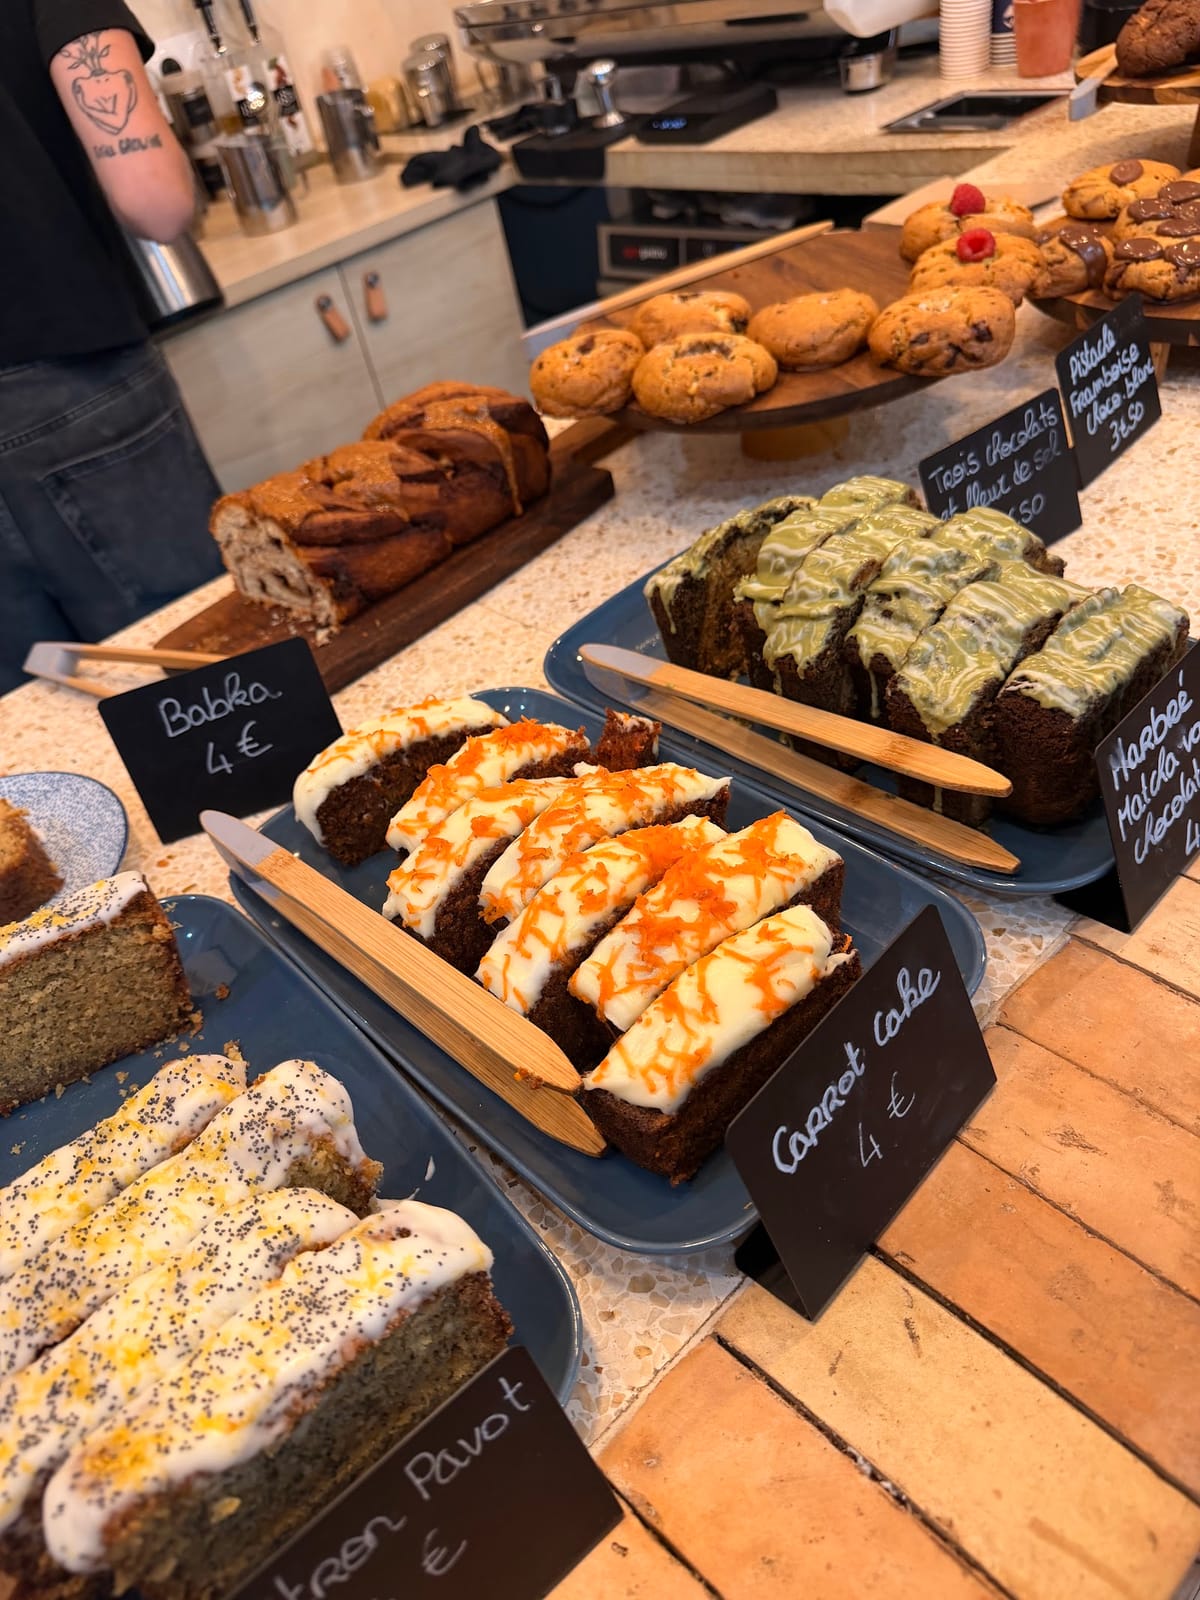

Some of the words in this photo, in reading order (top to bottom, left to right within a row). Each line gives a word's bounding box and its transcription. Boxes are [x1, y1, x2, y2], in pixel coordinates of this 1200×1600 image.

[1013, 460, 1033, 485] de
[160, 672, 283, 737] Babka
[207, 742, 234, 774] 4
[237, 720, 273, 757] €
[858, 1122, 884, 1167] 4
[887, 1071, 915, 1119] €
[404, 1377, 530, 1500] Pavot
[422, 1528, 467, 1575] €
